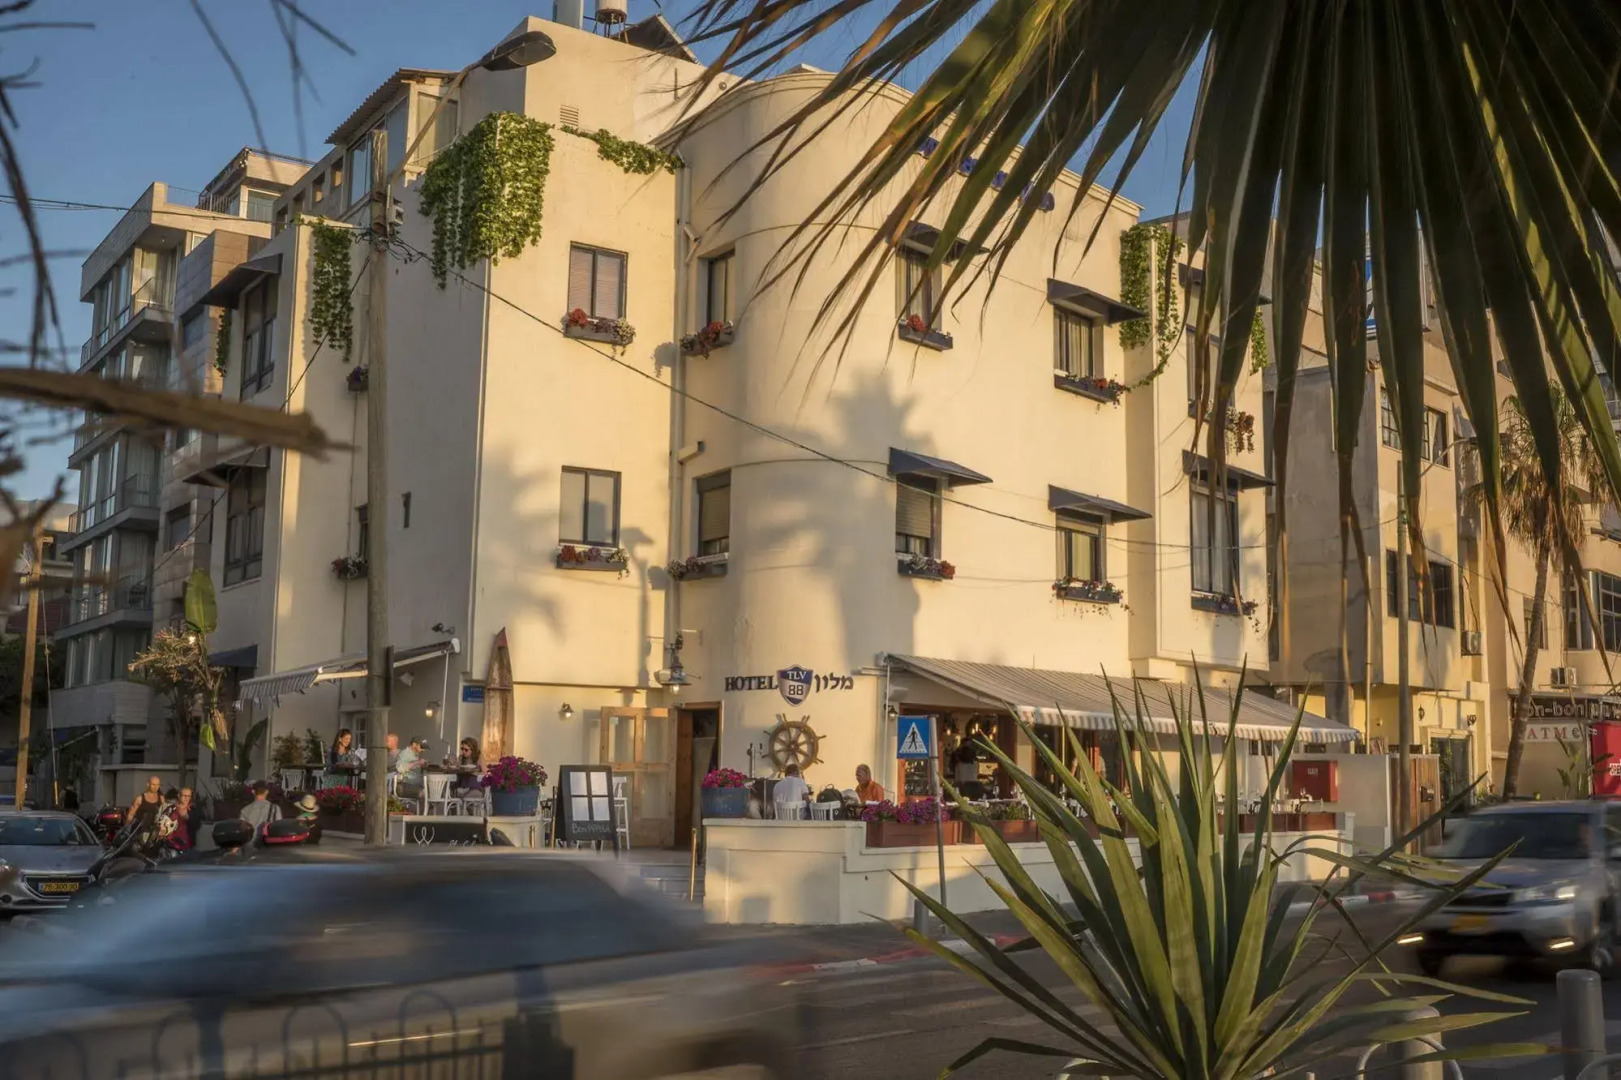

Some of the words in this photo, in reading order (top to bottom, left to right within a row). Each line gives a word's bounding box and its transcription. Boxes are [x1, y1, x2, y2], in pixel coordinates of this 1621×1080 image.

[787, 671, 807, 680] TLV
[725, 675, 778, 692] HOTEL
[814, 672, 854, 693] מלון
[788, 684, 804, 696] 88
[1527, 727, 1567, 740] ATM
